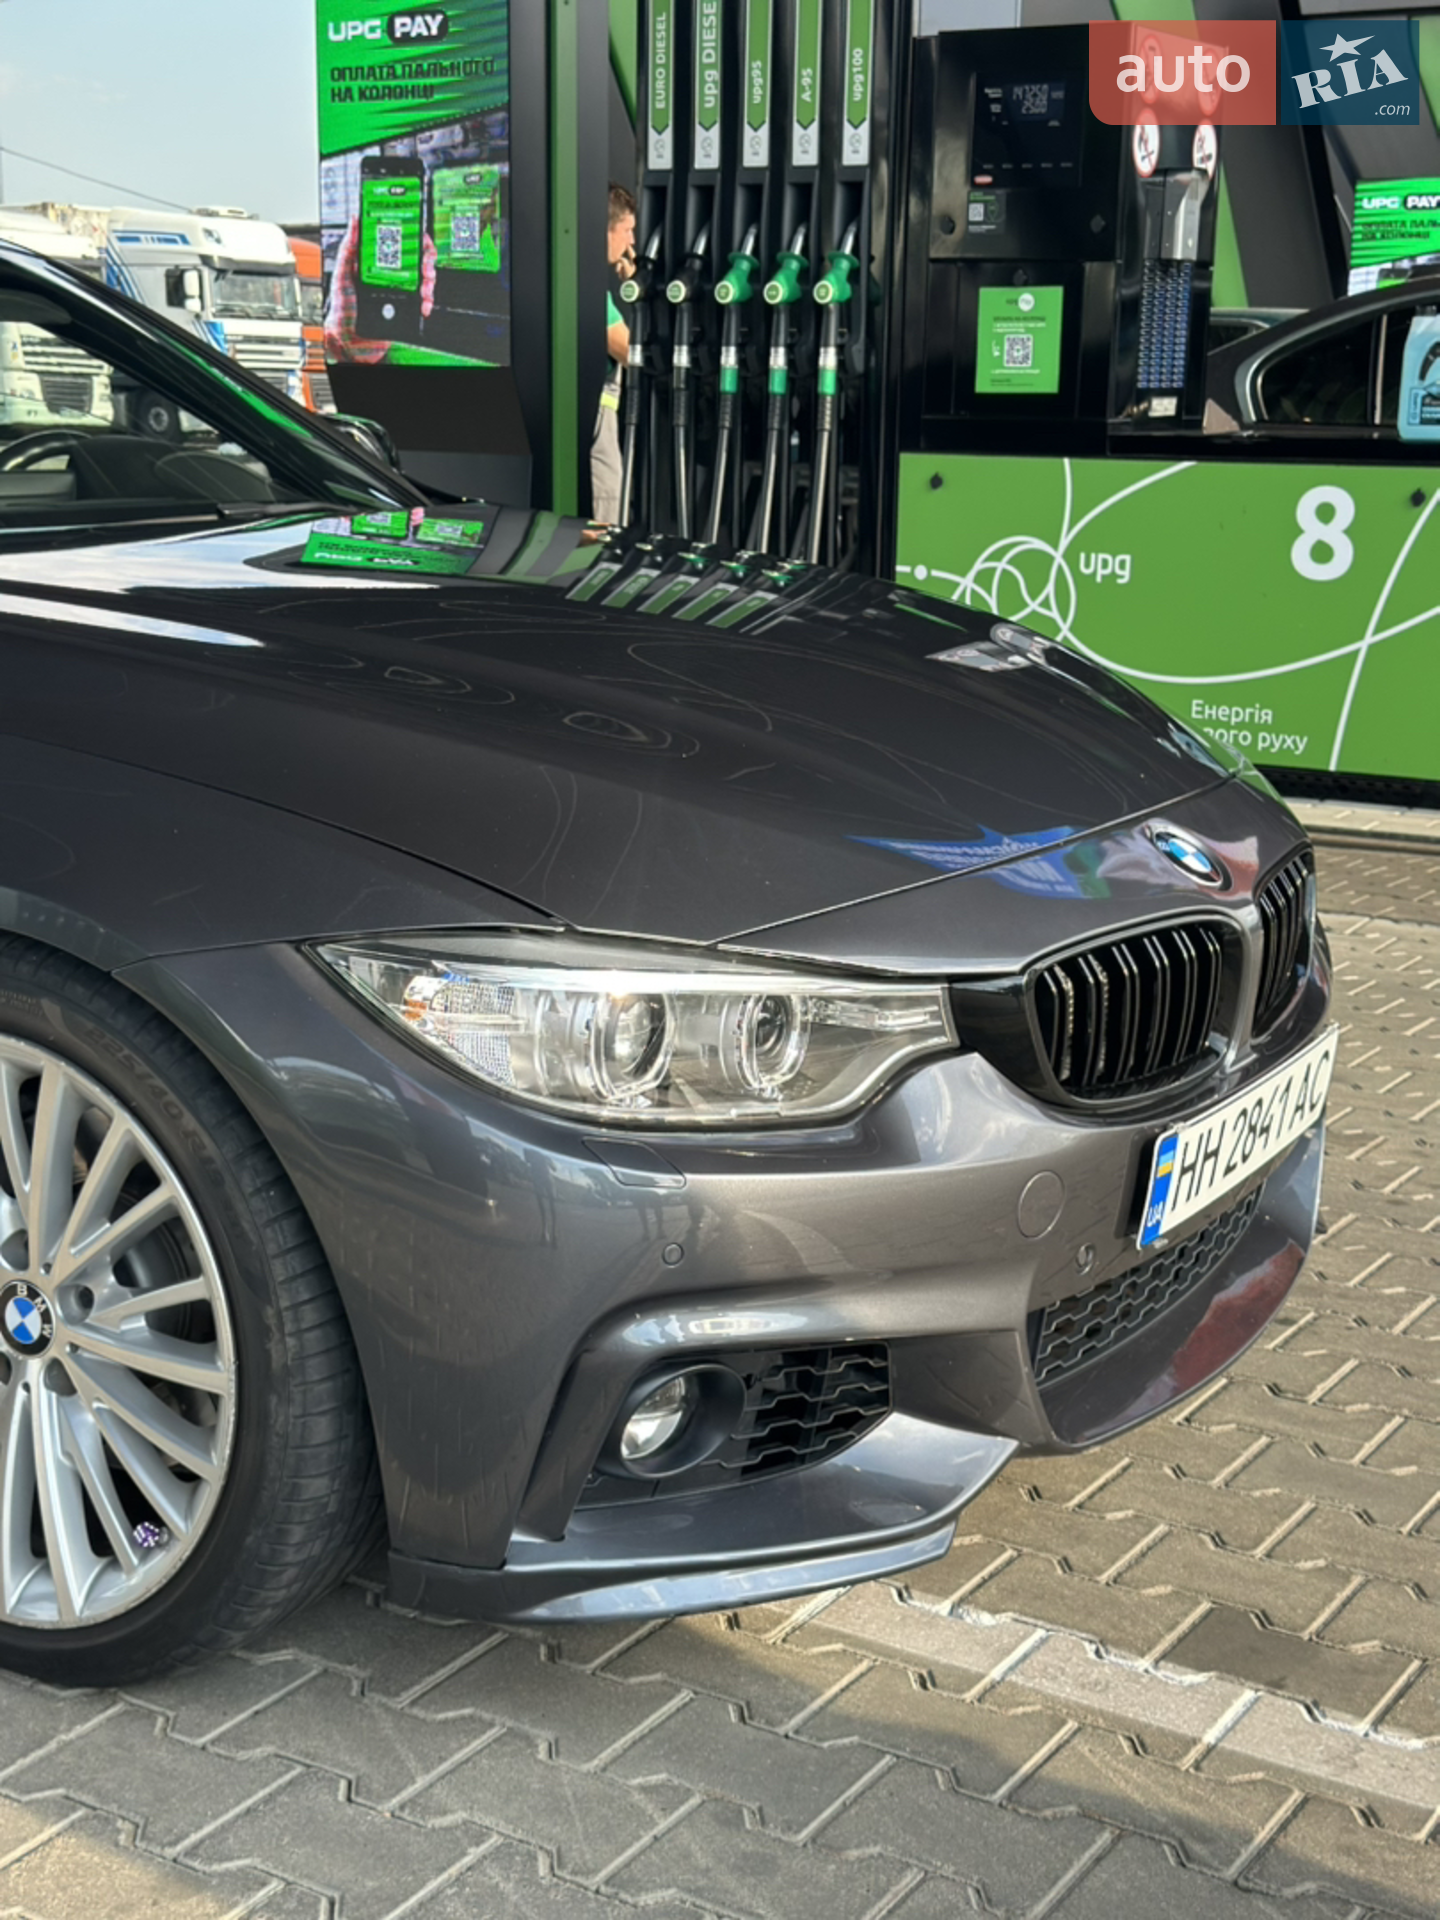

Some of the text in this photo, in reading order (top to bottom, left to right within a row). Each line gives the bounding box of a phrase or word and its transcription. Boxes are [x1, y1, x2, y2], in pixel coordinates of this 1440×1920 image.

[328, 14, 444, 42] UPG PAY
[331, 58, 495, 82] ОПЛАТА ПАЛЬНОГО
[656, 12, 666, 109] EURO DIESEL
[852, 48, 865, 101] upg100
[331, 86, 353, 103] НА
[704, 70, 718, 108] upg
[752, 60, 763, 104] upg95
[1362, 195, 1440, 209] UPG PAY
[1291, 485, 1355, 581] 8
[1079, 552, 1131, 584] upg
[1190, 699, 1273, 726] Енергія
[1257, 731, 1308, 755] руху
[1171, 1049, 1331, 1212] HH 2841 AC
